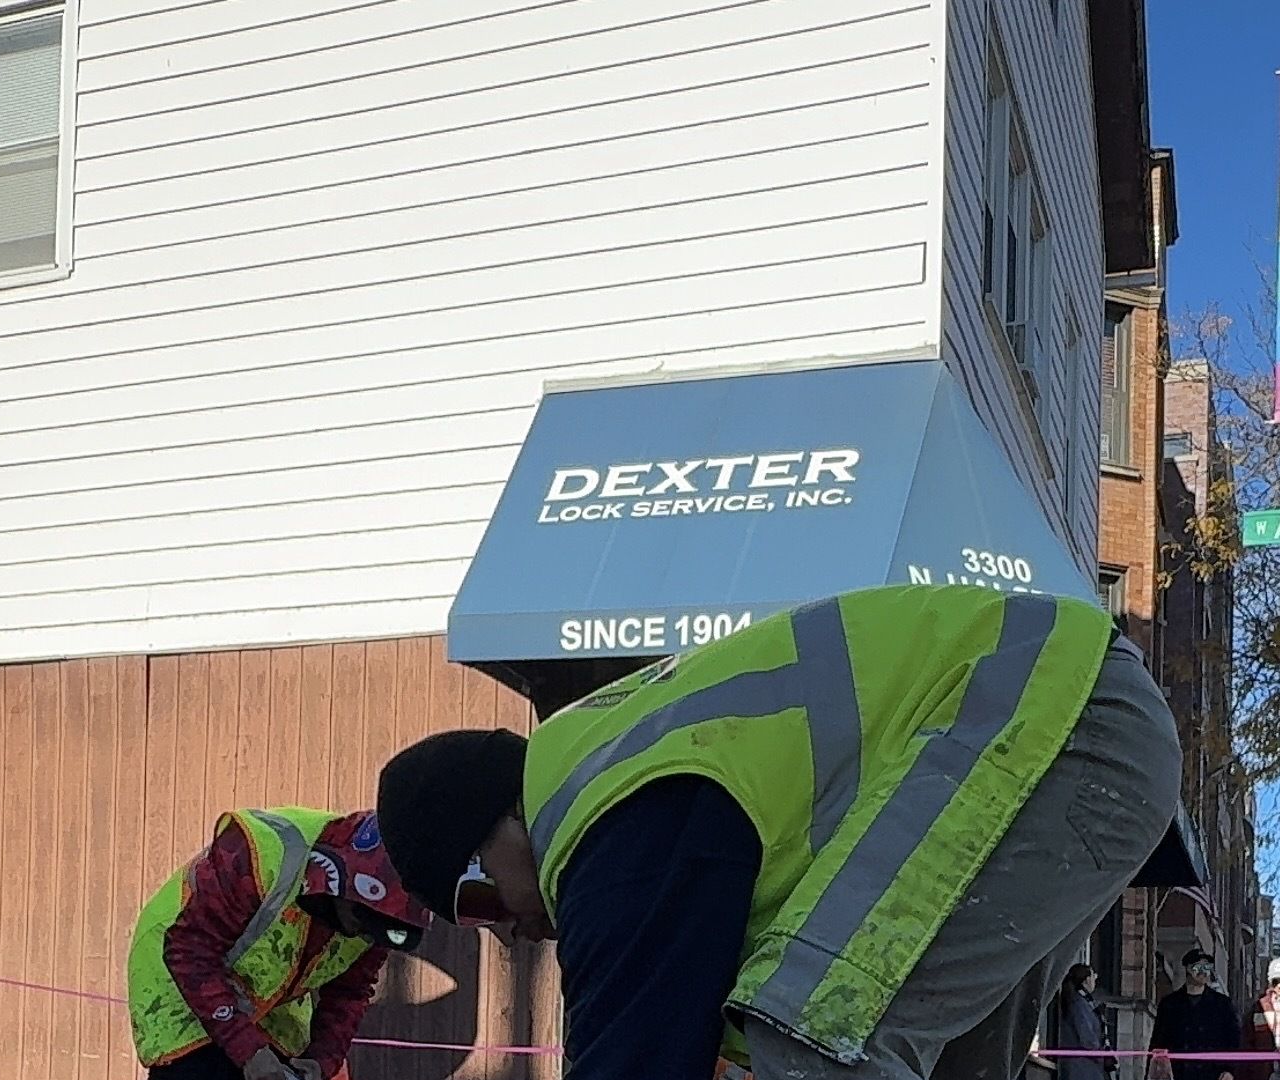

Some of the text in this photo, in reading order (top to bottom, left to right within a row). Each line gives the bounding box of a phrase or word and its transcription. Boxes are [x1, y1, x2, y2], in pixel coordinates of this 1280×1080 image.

[544, 449, 860, 502] DEXTER
[537, 488, 852, 524] LOCK SERVICE, INC.
[1256, 520, 1268, 534] W
[961, 548, 1032, 583] 3300
[560, 617, 665, 650] SINCE
